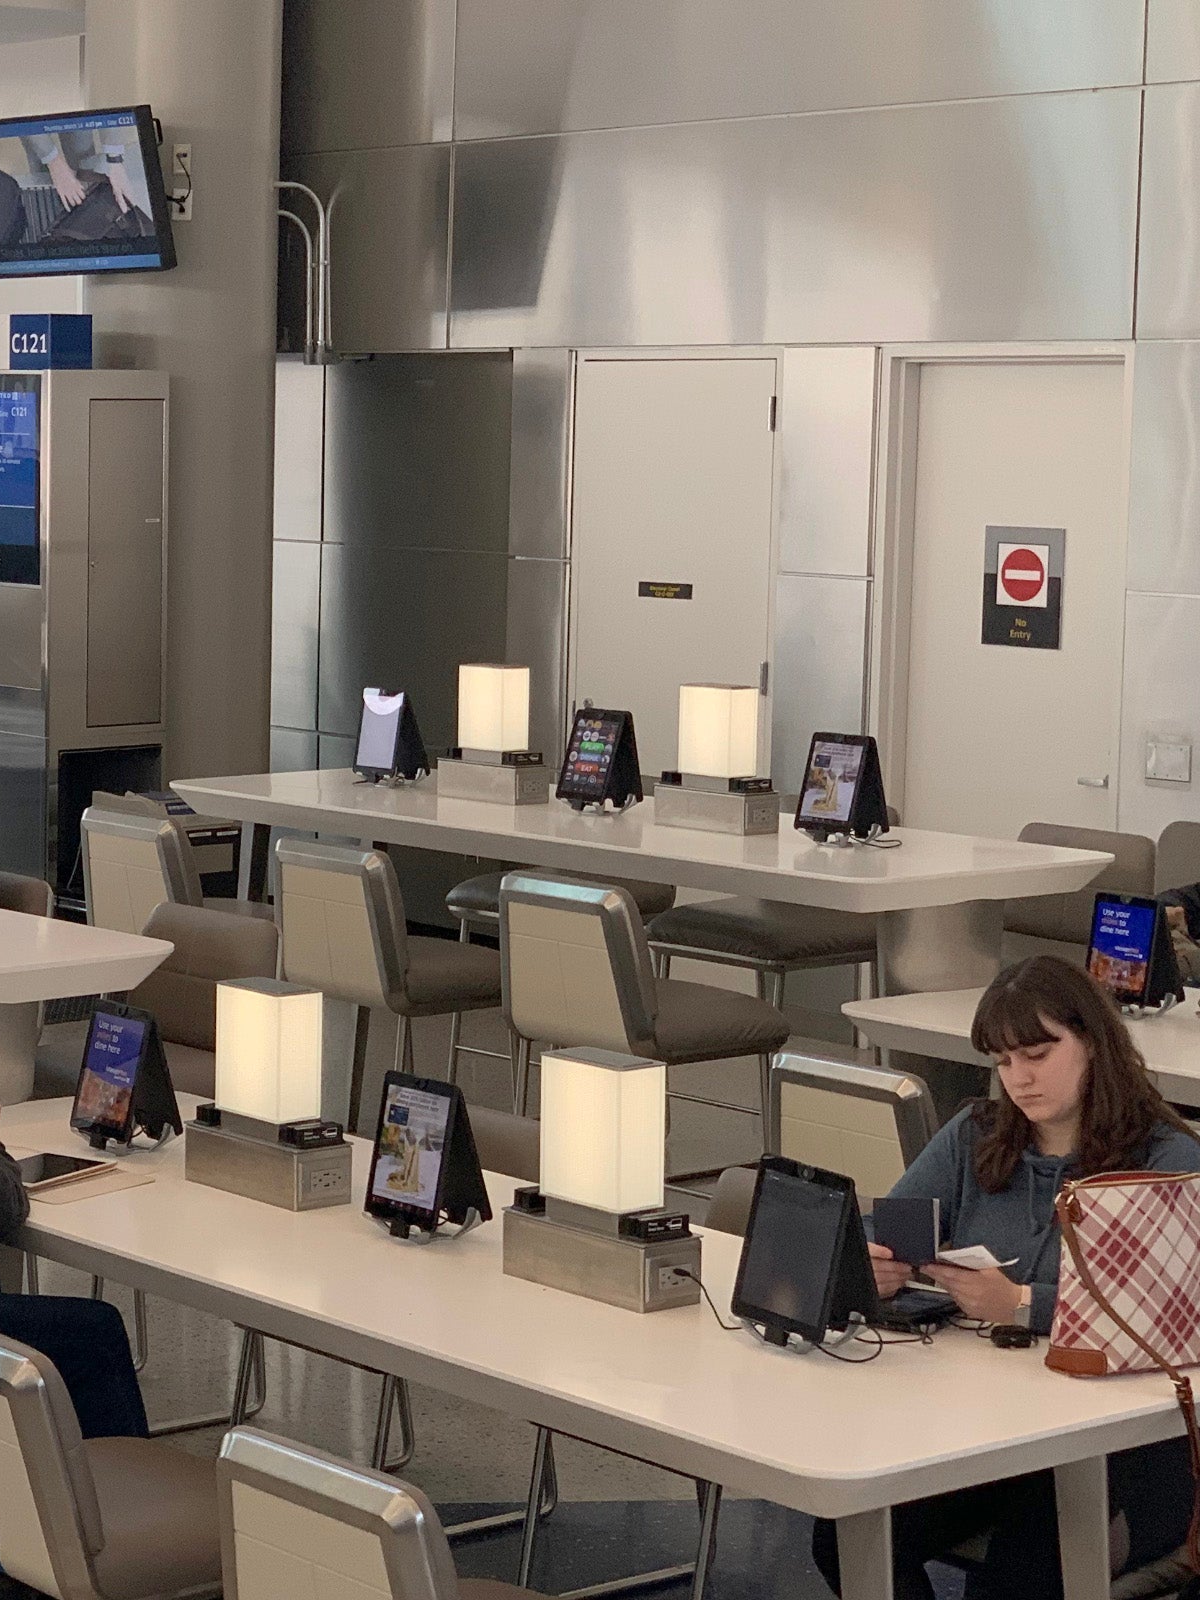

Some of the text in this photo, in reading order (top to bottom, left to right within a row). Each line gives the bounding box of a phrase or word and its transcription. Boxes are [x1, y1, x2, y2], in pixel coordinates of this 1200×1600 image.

[118, 117, 134, 125] C121
[11, 333, 48, 354] C121
[11, 406, 28, 417] C121
[1015, 618, 1027, 628] No
[1009, 629, 1031, 641] Entry
[1102, 908, 1131, 919] Use your
[1099, 925, 1130, 937] dine here
[98, 1020, 124, 1034] Use your
[111, 1034, 119, 1043] to
[94, 1040, 121, 1055] dine here
